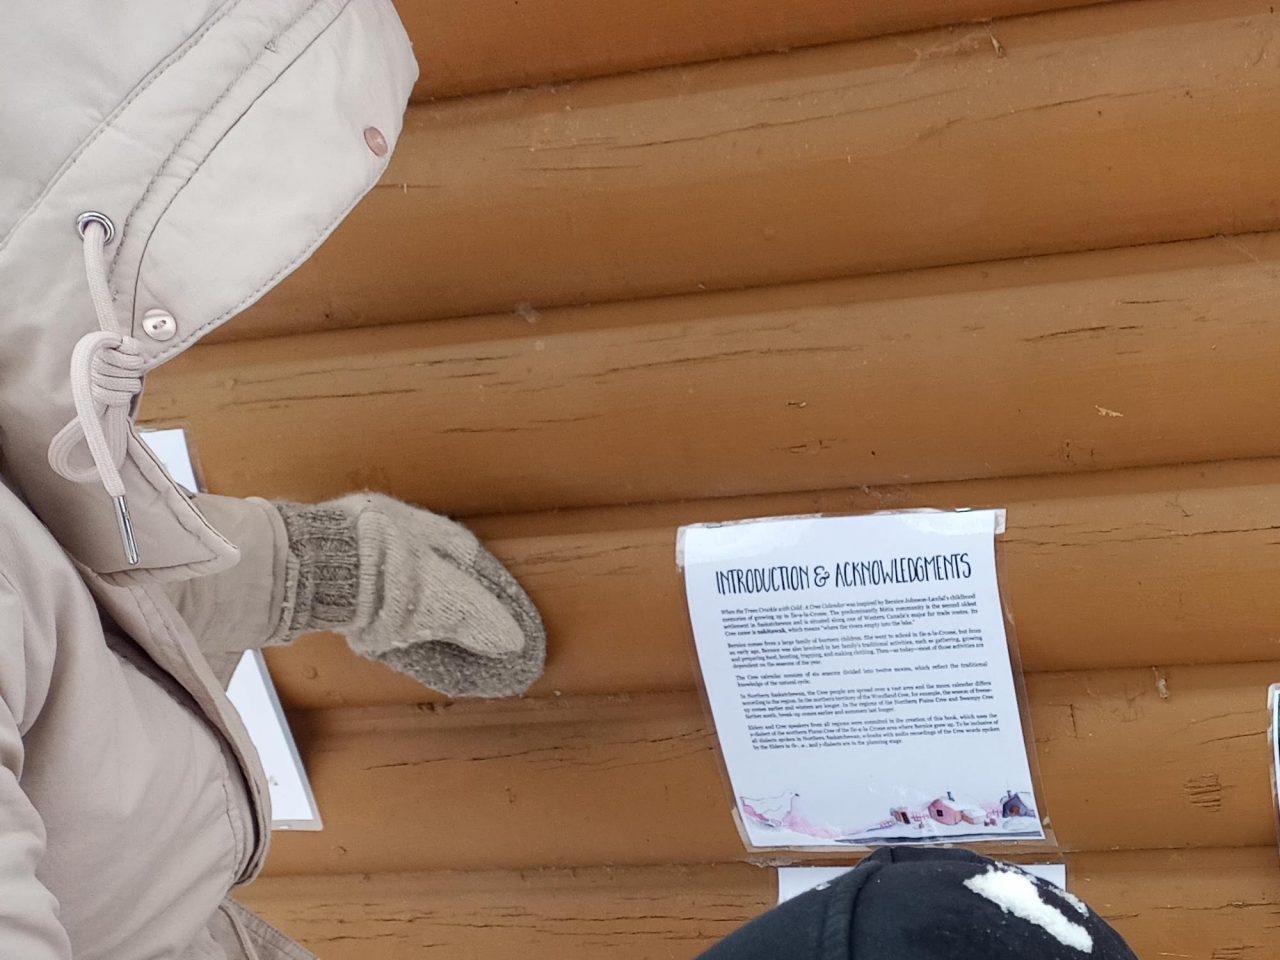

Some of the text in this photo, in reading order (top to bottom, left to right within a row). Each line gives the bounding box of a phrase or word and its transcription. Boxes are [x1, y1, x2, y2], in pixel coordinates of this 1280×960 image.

[716, 553, 972, 595] INTRODUCTION & ACKNOWLEDGMENTS
